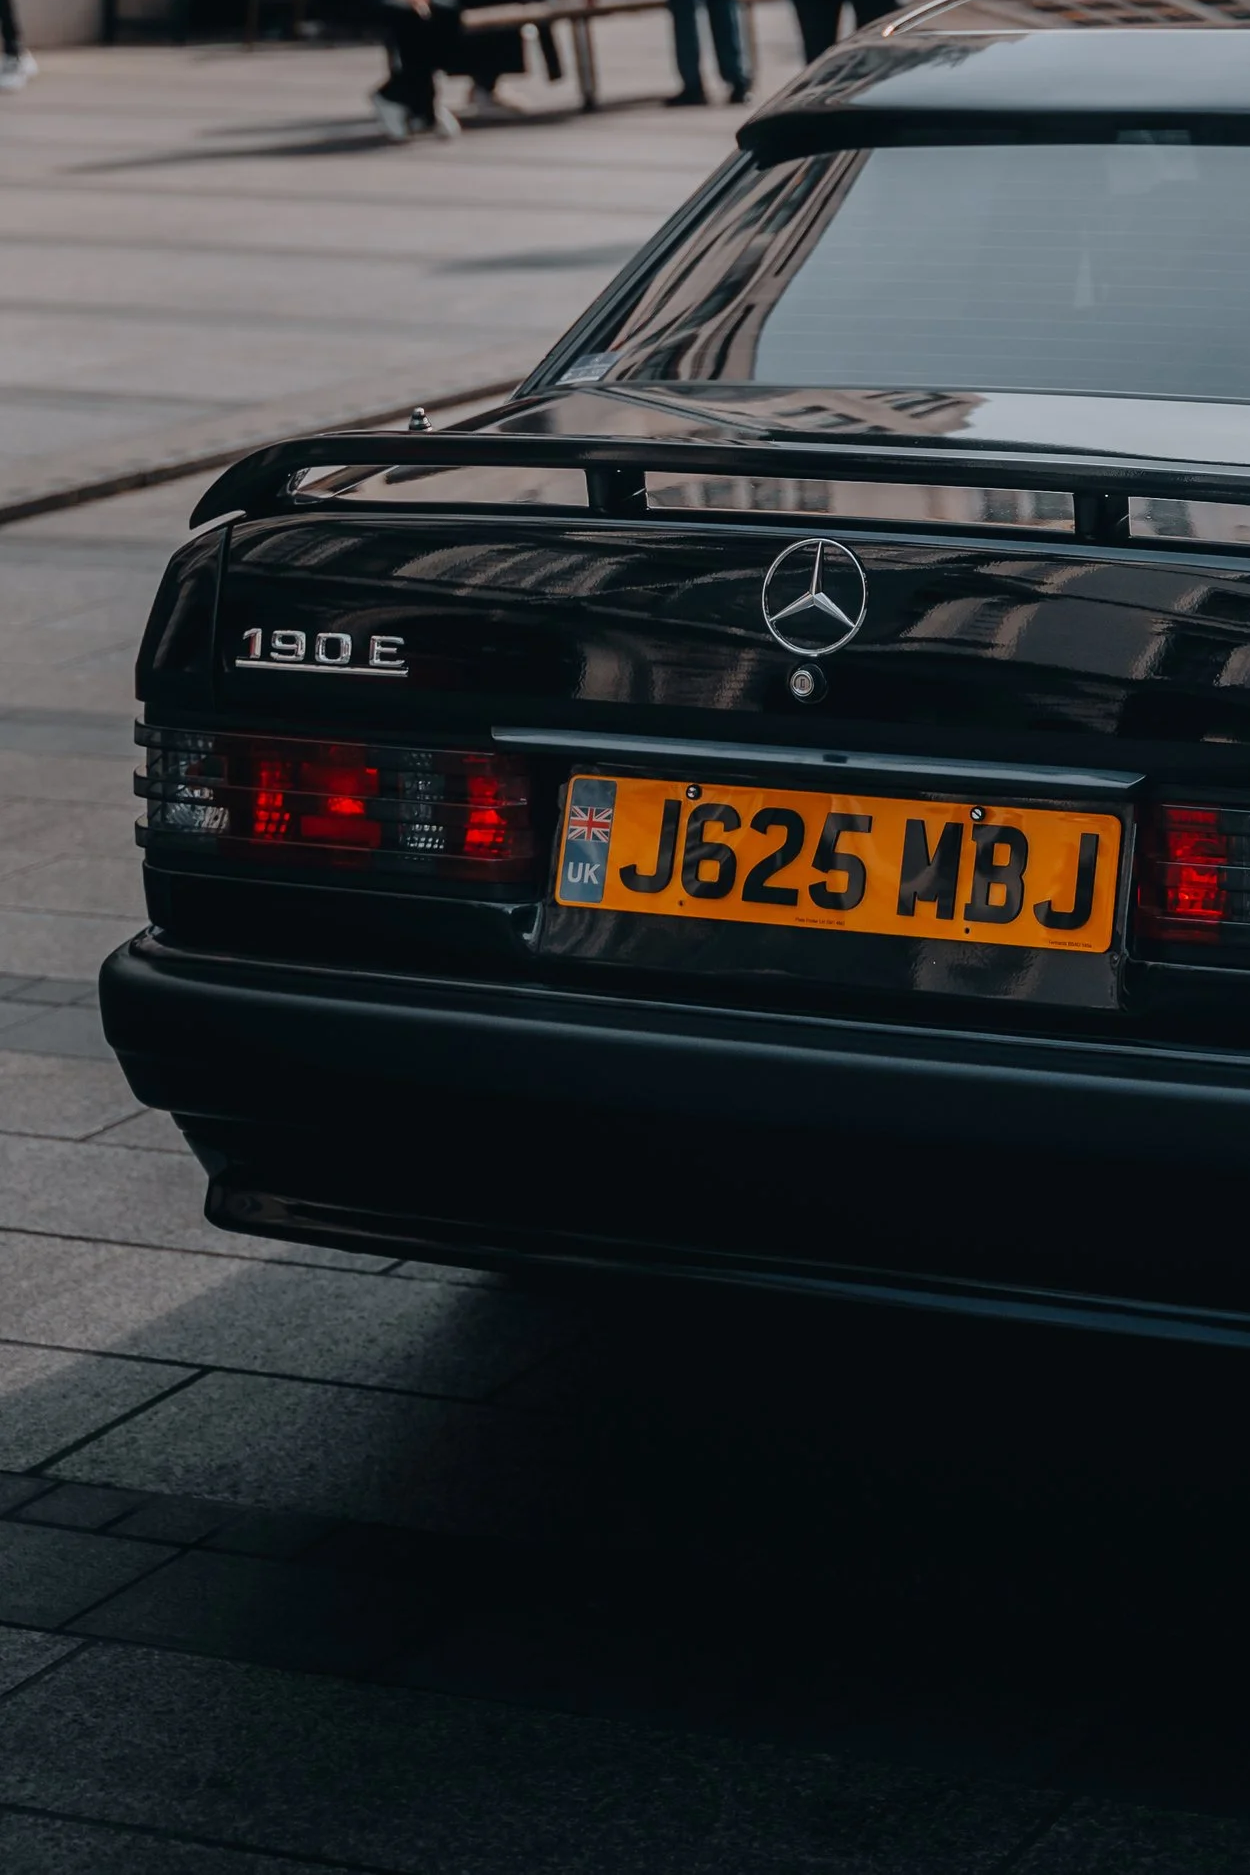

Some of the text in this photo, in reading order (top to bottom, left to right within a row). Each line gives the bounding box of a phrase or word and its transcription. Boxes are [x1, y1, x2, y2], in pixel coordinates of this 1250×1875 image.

[243, 628, 405, 668] 190 E
[567, 861, 601, 885] UK
[619, 798, 1099, 930] J625 MBJ
